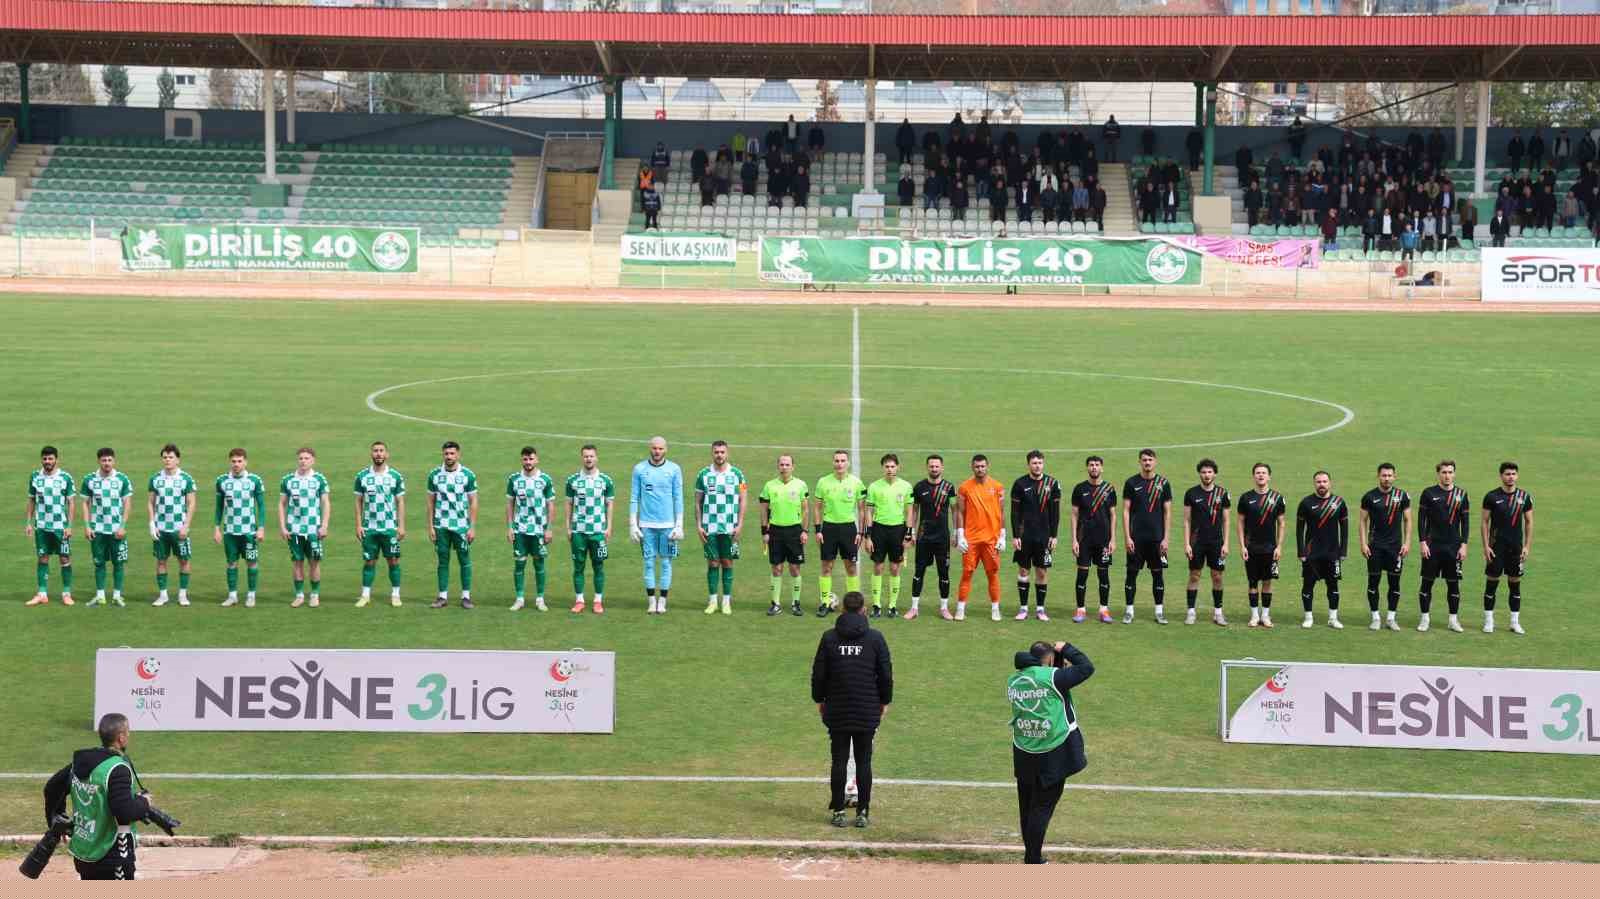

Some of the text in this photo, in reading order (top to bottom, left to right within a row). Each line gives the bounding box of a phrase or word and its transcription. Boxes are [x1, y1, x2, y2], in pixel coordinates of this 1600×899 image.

[185, 227, 358, 260] DİRİLİŞ 40
[630, 239, 729, 259] SEN İLK AŞKIM
[869, 240, 1093, 275] DİRİLİŞ 40
[839, 645, 863, 656] TFF
